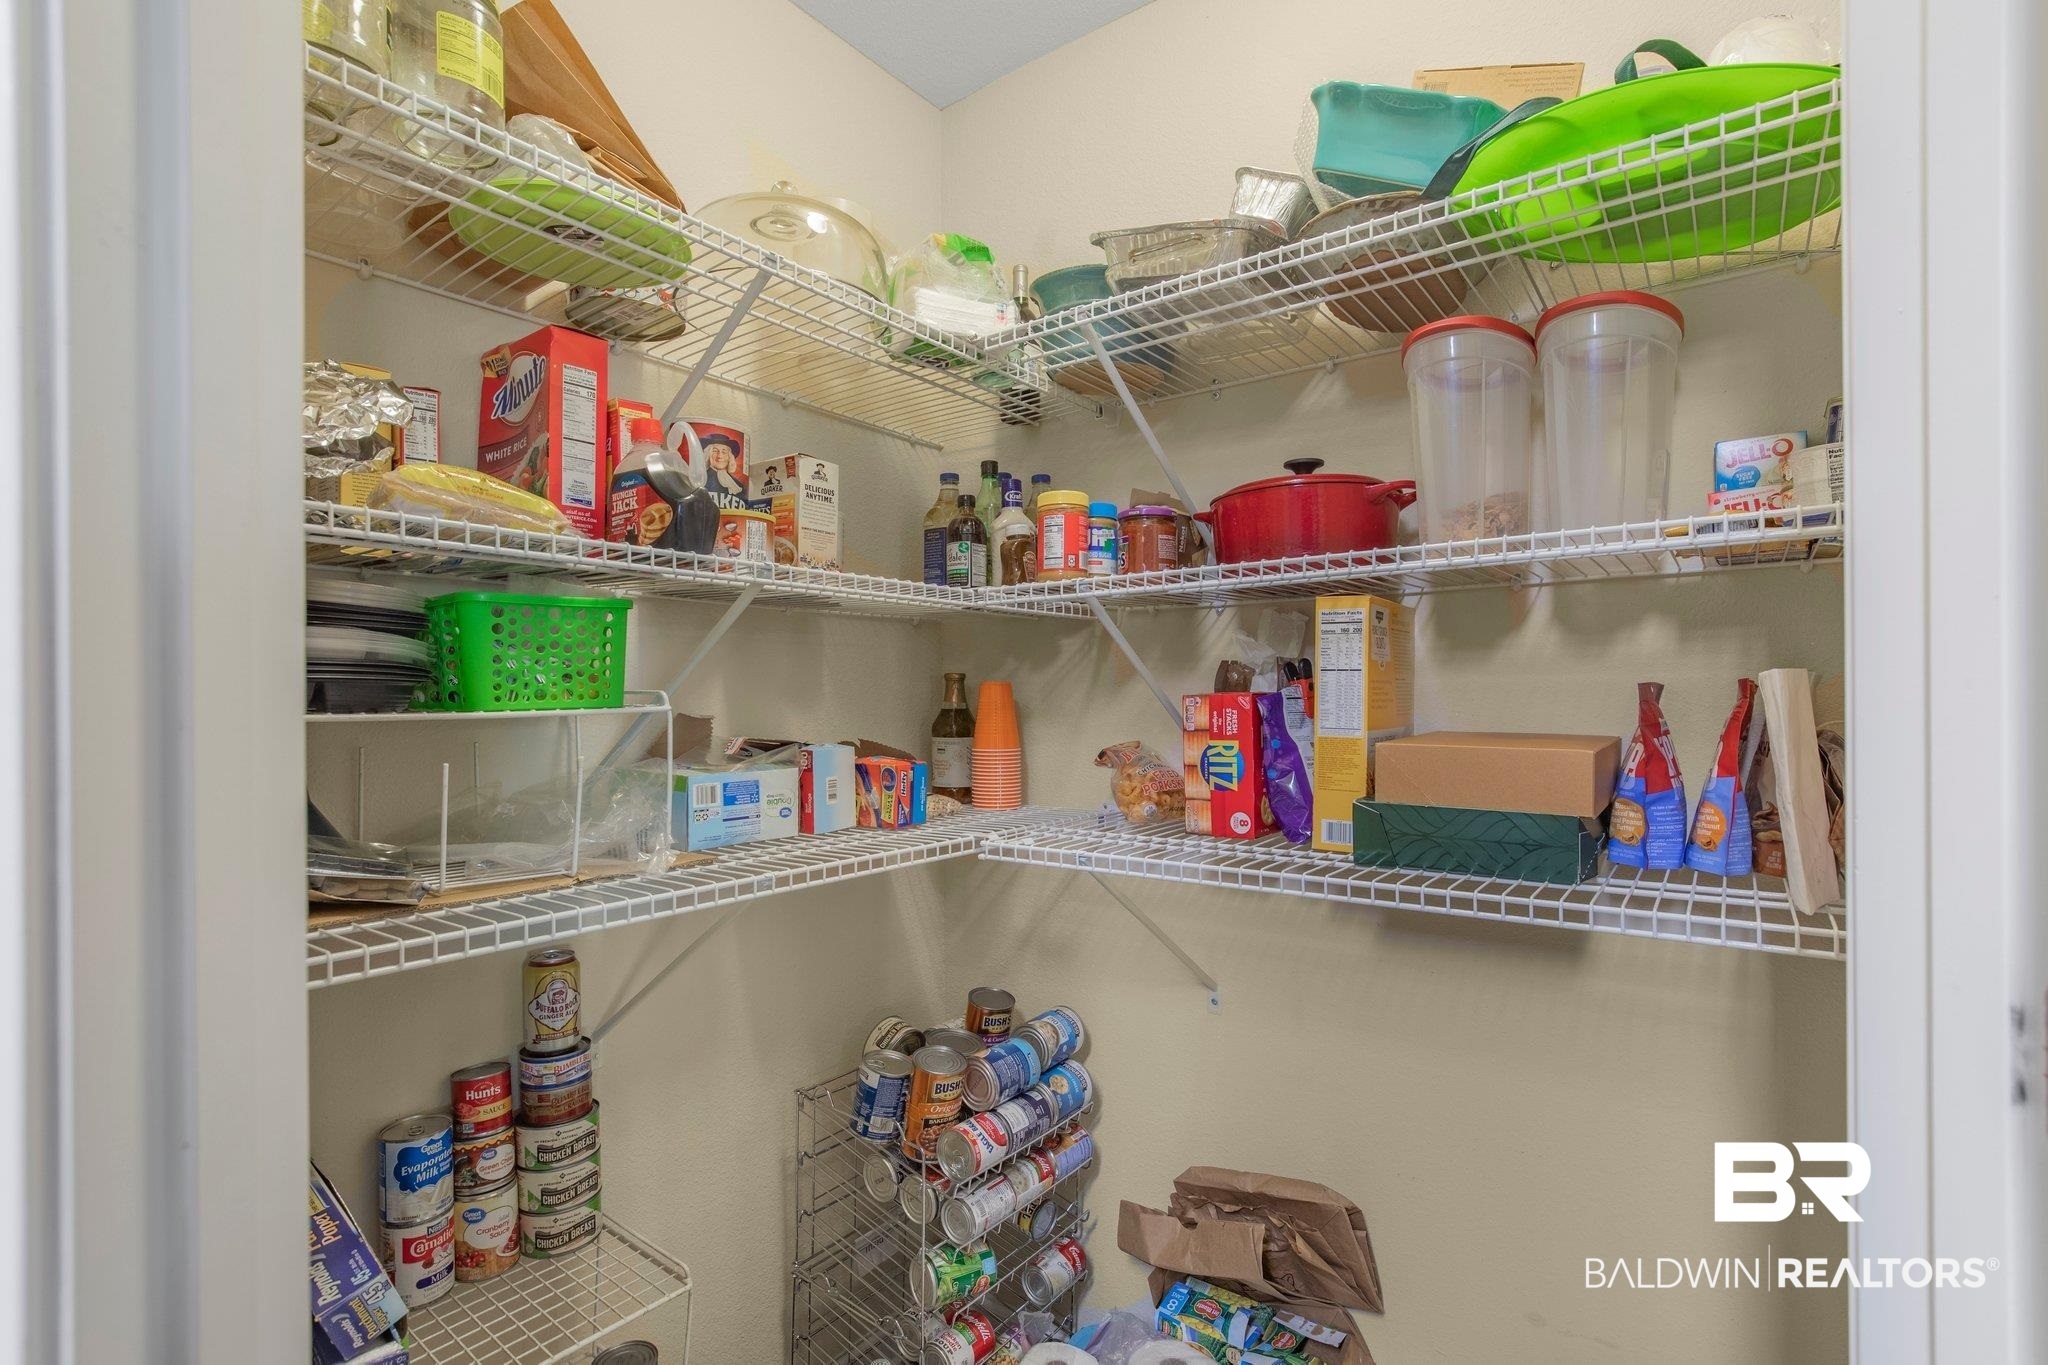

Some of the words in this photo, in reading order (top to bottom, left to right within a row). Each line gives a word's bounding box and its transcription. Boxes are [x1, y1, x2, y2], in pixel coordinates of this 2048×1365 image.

[493, 356, 546, 418] Minute
[485, 446, 512, 462] WHITE
[513, 437, 528, 453] RICE
[1726, 438, 1794, 468] JELL-O
[811, 474, 828, 482] QUAKER
[612, 489, 637, 501] HUNGRY
[761, 485, 783, 495] QUAKER
[804, 484, 835, 496] DELICIOUS
[805, 492, 835, 504] ANYTIME.
[611, 497, 639, 514] JACK
[1207, 740, 1240, 792] RITZ
[1153, 769, 1179, 781] FRIED
[1142, 779, 1171, 796] PORK
[1239, 819, 1249, 827] 8
[535, 1000, 564, 1013] BUFFALO
[564, 994, 578, 1010] ROCK
[538, 1012, 564, 1020] GINGER
[553, 1056, 582, 1075] BUMBLE
[483, 1103, 507, 1115] SAUCE
[538, 1146, 572, 1163] CHICKEN
[573, 1134, 596, 1153] BREAST
[977, 1131, 994, 1154] EAGLE
[416, 1166, 439, 1183] Milk
[480, 1163, 500, 1171] Green
[542, 1188, 576, 1205] CHICKEN
[576, 1174, 599, 1194] BREAST
[464, 1210, 482, 1219] Great
[313, 1212, 343, 1246] Paper
[476, 1219, 511, 1237] Cranberry
[489, 1227, 511, 1240] Sauce
[536, 1231, 570, 1249] CHICKEN
[570, 1219, 596, 1239] BREAST
[351, 1268, 372, 1286] 45
[431, 1268, 449, 1284] Milk
[362, 1281, 386, 1305] 45
[1172, 1292, 1184, 1301] CANS
[1167, 1299, 1179, 1311] 8
[349, 1297, 381, 1339] Parchment
[374, 1306, 391, 1330] Paper
[340, 1318, 365, 1349] Reynolds
[934, 1338, 954, 1356] SOUP
